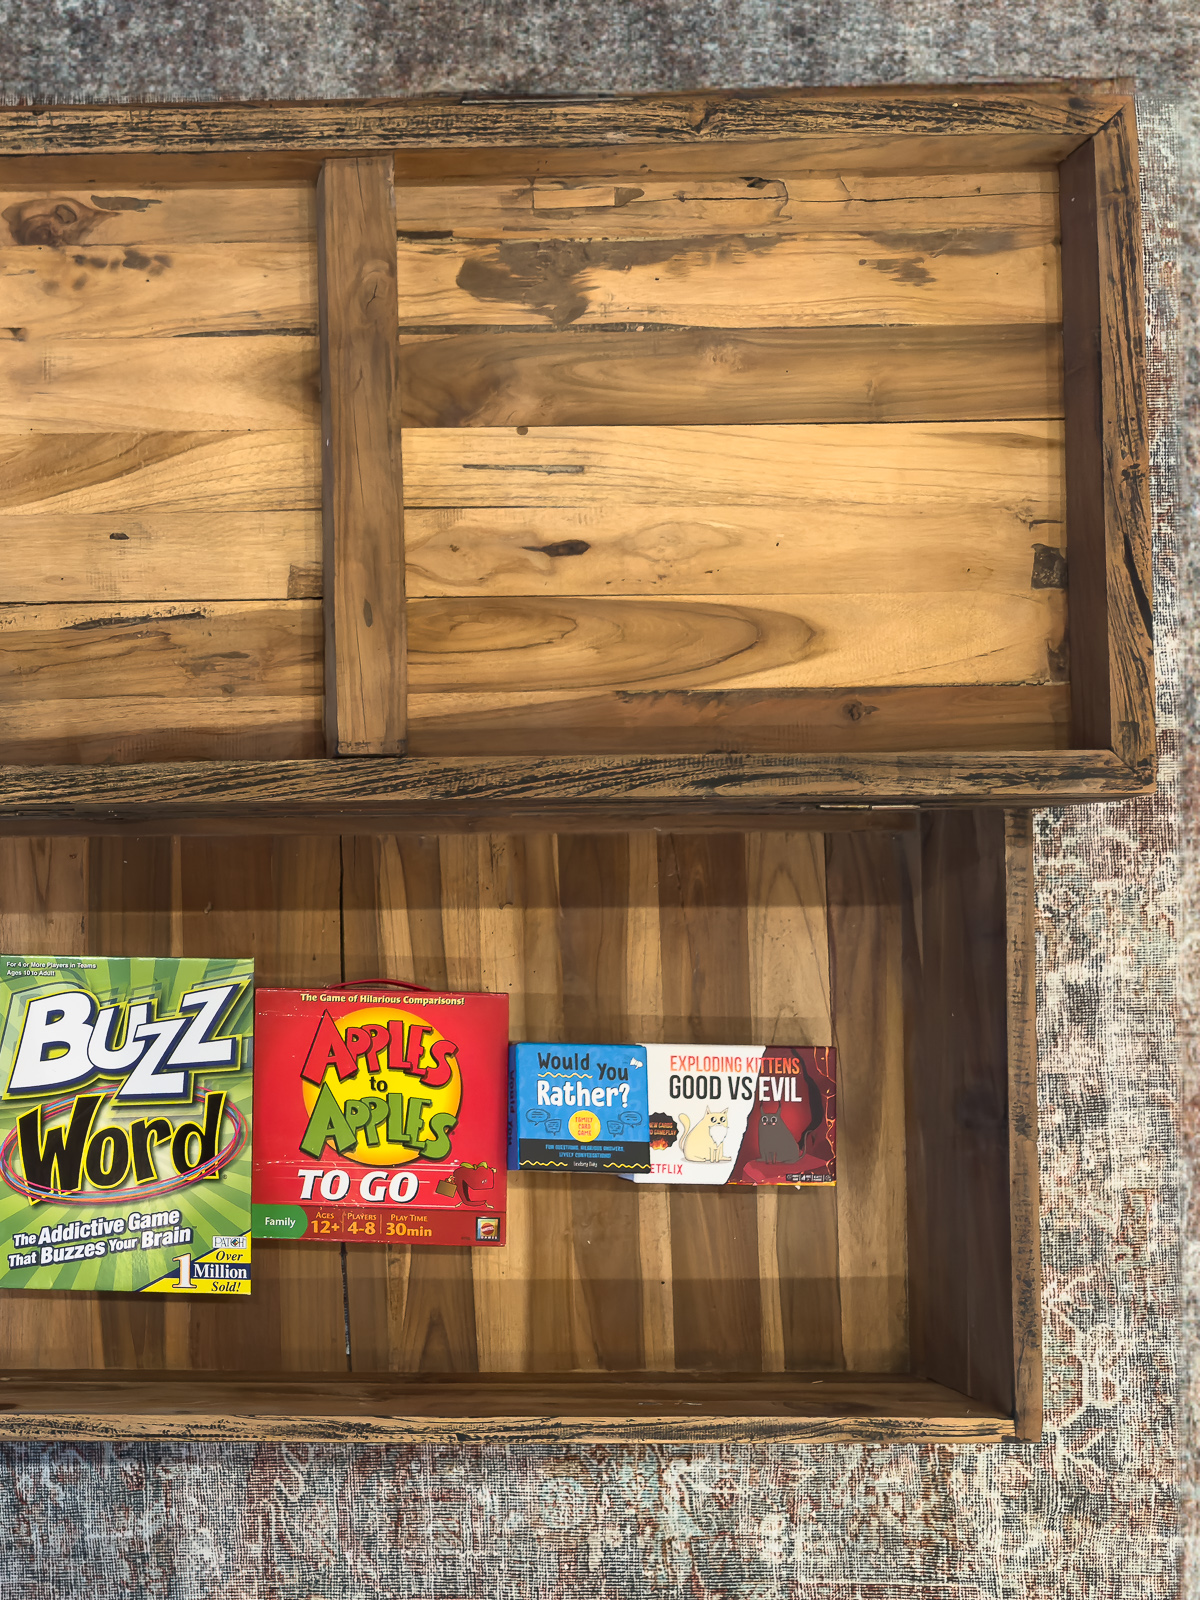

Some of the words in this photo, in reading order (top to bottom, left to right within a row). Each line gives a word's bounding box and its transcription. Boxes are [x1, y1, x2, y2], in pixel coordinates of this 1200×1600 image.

[300, 993, 317, 1002] The
[320, 993, 346, 1002] Game
[348, 994, 358, 1003] of
[360, 995, 401, 1004] Hilarious
[403, 995, 465, 1007] Comparisons!
[3, 979, 248, 1104] BUZZ
[300, 1008, 459, 1088] APPLES
[537, 1052, 590, 1071] Would
[596, 1063, 629, 1081] You
[670, 1055, 742, 1073] EXPLODING
[746, 1057, 800, 1075] KITTENS
[369, 1076, 389, 1093] to
[669, 1074, 722, 1100] GOOD
[727, 1075, 753, 1101] VS
[758, 1076, 803, 1102] EVIL
[537, 1080, 630, 1108] Rather?
[299, 1081, 459, 1160] APPLES
[16, 1091, 229, 1206] Word
[650, 1163, 683, 1175] ETFLIX
[297, 1169, 351, 1202] TO
[359, 1171, 419, 1203] GO
[264, 1217, 296, 1229] Family
[315, 1211, 335, 1219] AGES
[347, 1212, 377, 1221] PLAYERS
[390, 1213, 409, 1222] PLAY
[410, 1214, 428, 1222] TIME
[13, 1232, 38, 1247] The
[38, 1216, 126, 1246] Addictive
[128, 1209, 182, 1232] Game
[311, 1220, 340, 1234] 12+
[347, 1222, 376, 1235] 4-8
[385, 1222, 433, 1237] 30min
[8, 1251, 38, 1269] That
[40, 1240, 107, 1265] Buzzes
[108, 1237, 139, 1252] Your
[141, 1226, 193, 1250] Brain
[214, 1236, 247, 1247] PATCH
[216, 1250, 243, 1261] Over
[172, 1252, 198, 1289] 1
[193, 1263, 248, 1279] Million
[211, 1281, 241, 1292] Sold!
